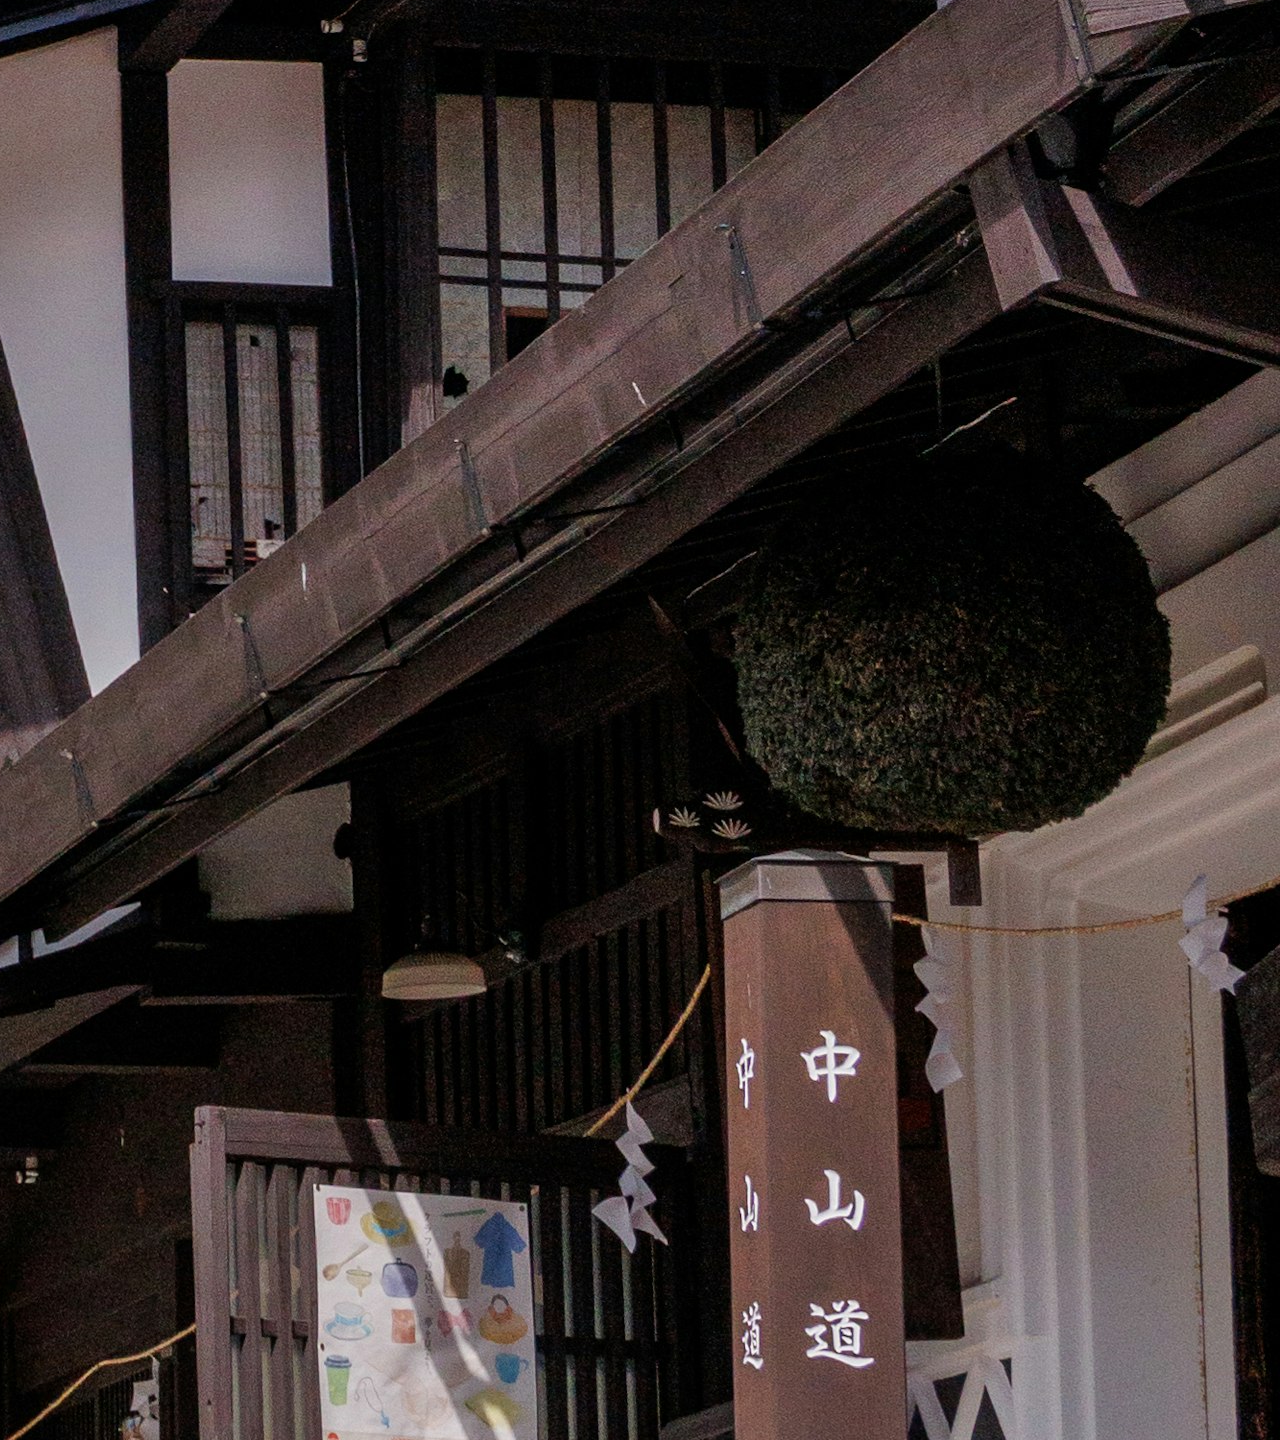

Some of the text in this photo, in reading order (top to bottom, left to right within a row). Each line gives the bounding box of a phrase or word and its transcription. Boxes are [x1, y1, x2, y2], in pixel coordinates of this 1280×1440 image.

[734, 1037, 765, 1371] 中山道
[799, 1028, 875, 1369] 中山道
